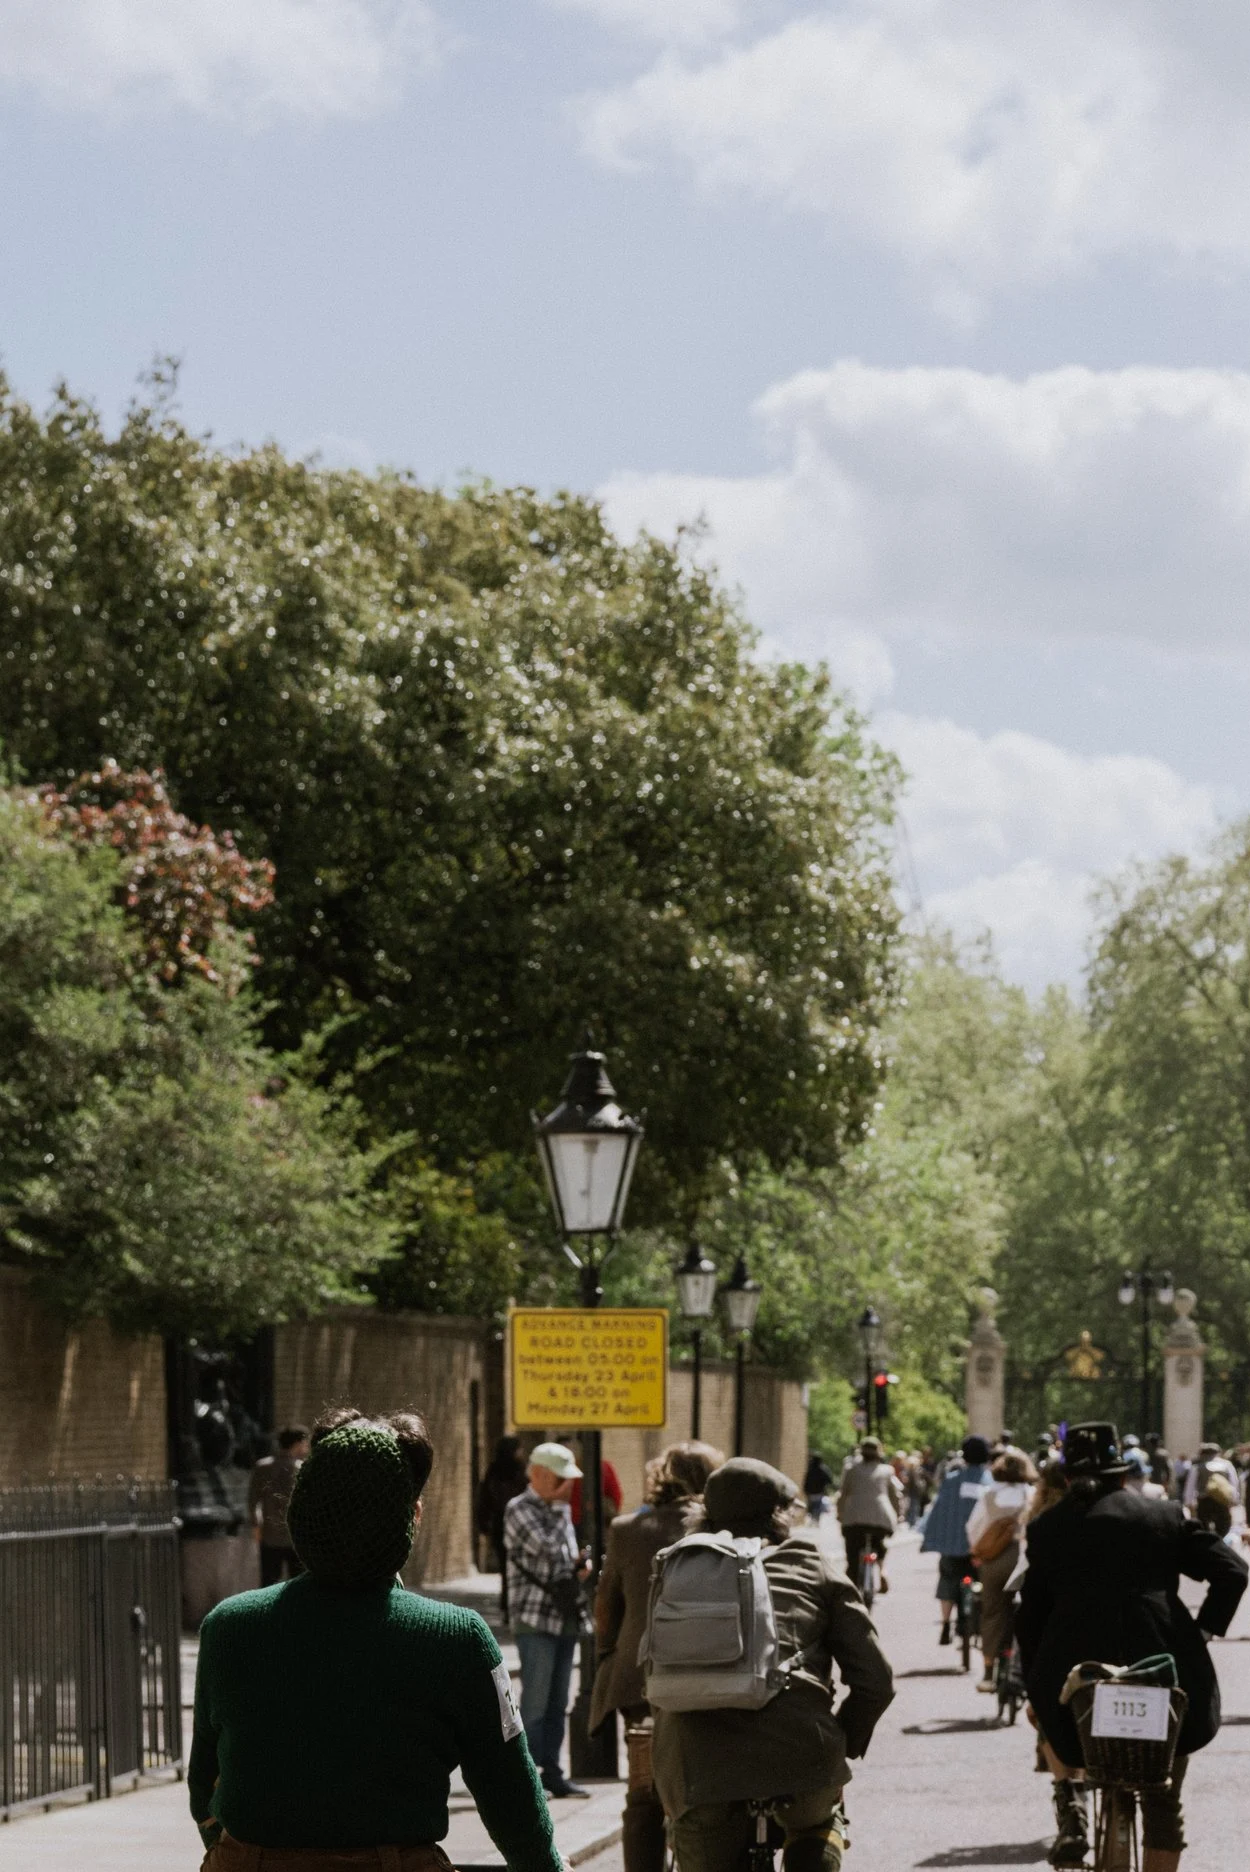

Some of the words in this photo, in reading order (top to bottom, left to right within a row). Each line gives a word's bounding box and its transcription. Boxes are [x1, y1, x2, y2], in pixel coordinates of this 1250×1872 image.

[530, 1335, 576, 1348] ROAD
[581, 1335, 648, 1348] CLOSED
[519, 1353, 582, 1364] between
[641, 1355, 659, 1365] on
[523, 1368, 588, 1383] Thursday
[594, 1368, 614, 1381] 23
[621, 1368, 656, 1384] April
[548, 1385, 558, 1399] &
[612, 1387, 631, 1399] on
[527, 1401, 584, 1416] Monday
[590, 1401, 608, 1415] 27
[614, 1401, 650, 1416] April
[1113, 1701, 1147, 1717] 1113
